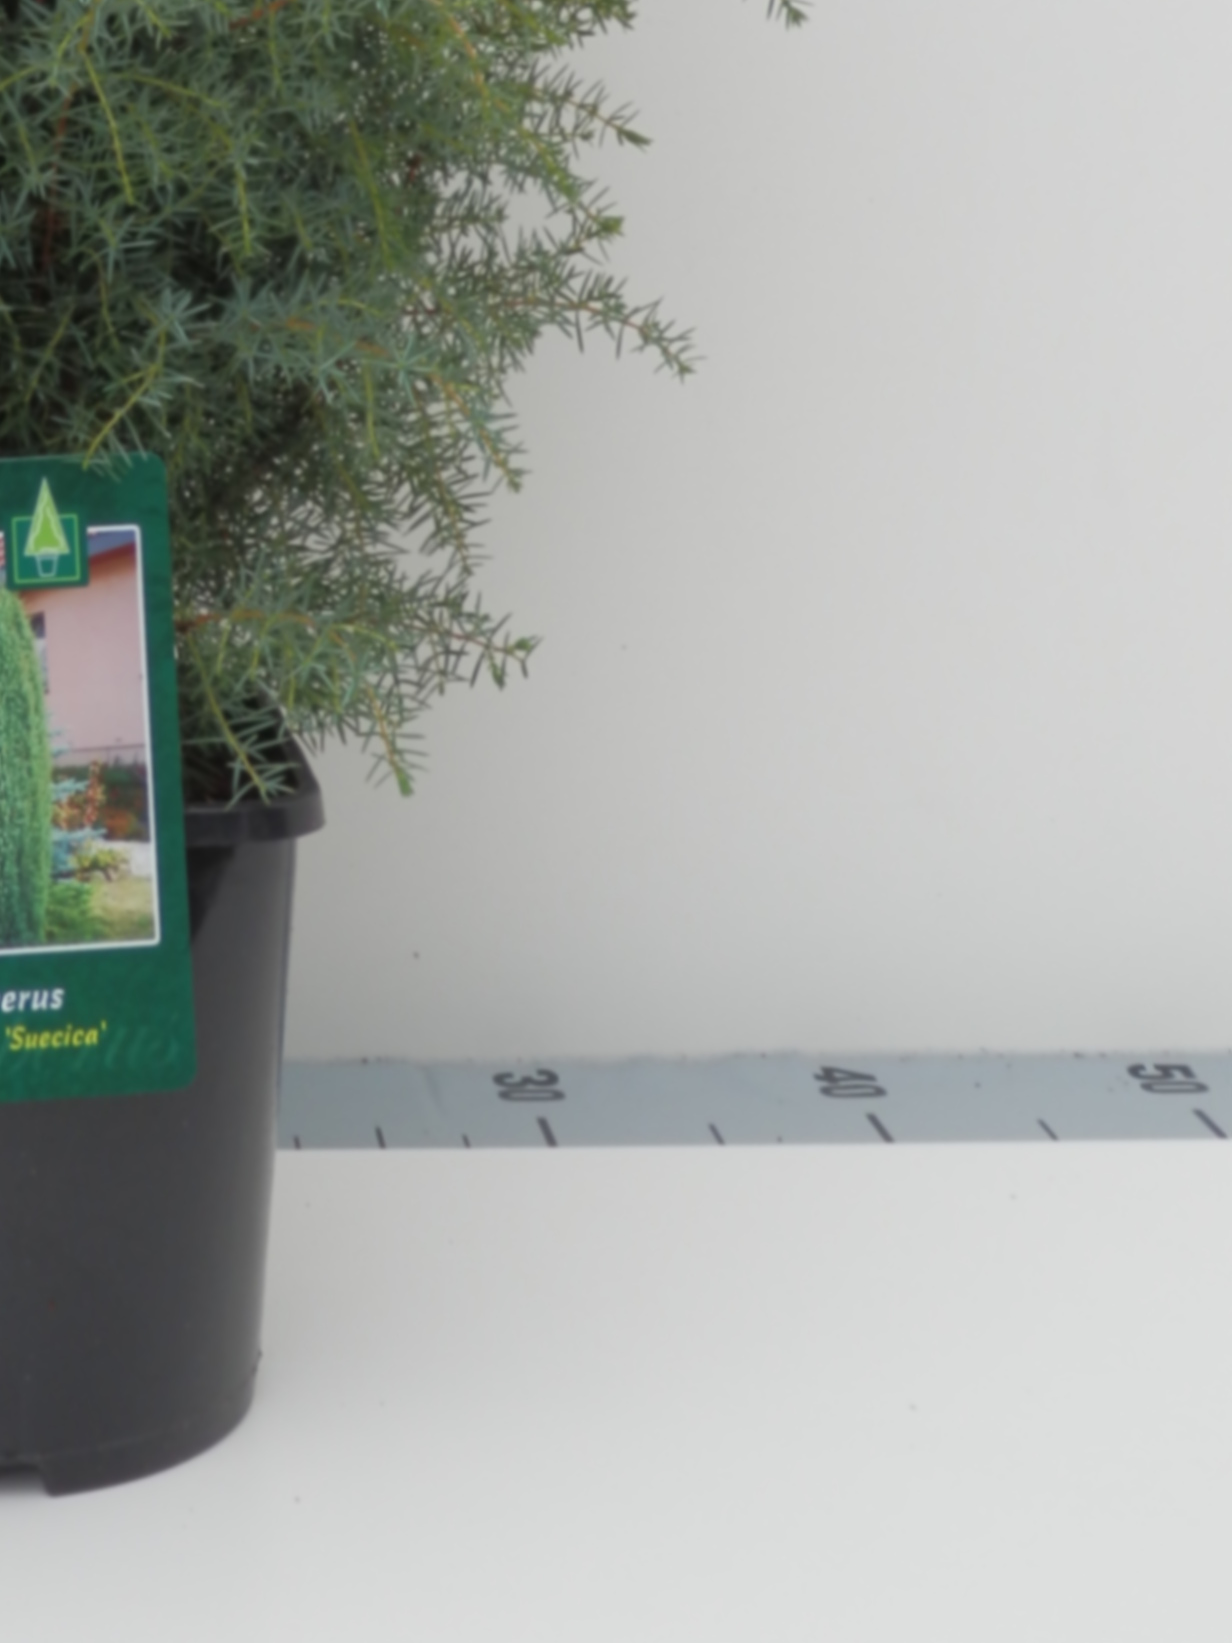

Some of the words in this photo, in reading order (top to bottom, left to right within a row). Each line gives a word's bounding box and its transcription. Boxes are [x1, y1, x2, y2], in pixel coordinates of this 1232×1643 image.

[6, 1020, 107, 1050] 'Suecica'
[492, 1067, 565, 1102] 30
[813, 1066, 887, 1098] 40
[1126, 1063, 1209, 1093] 50
